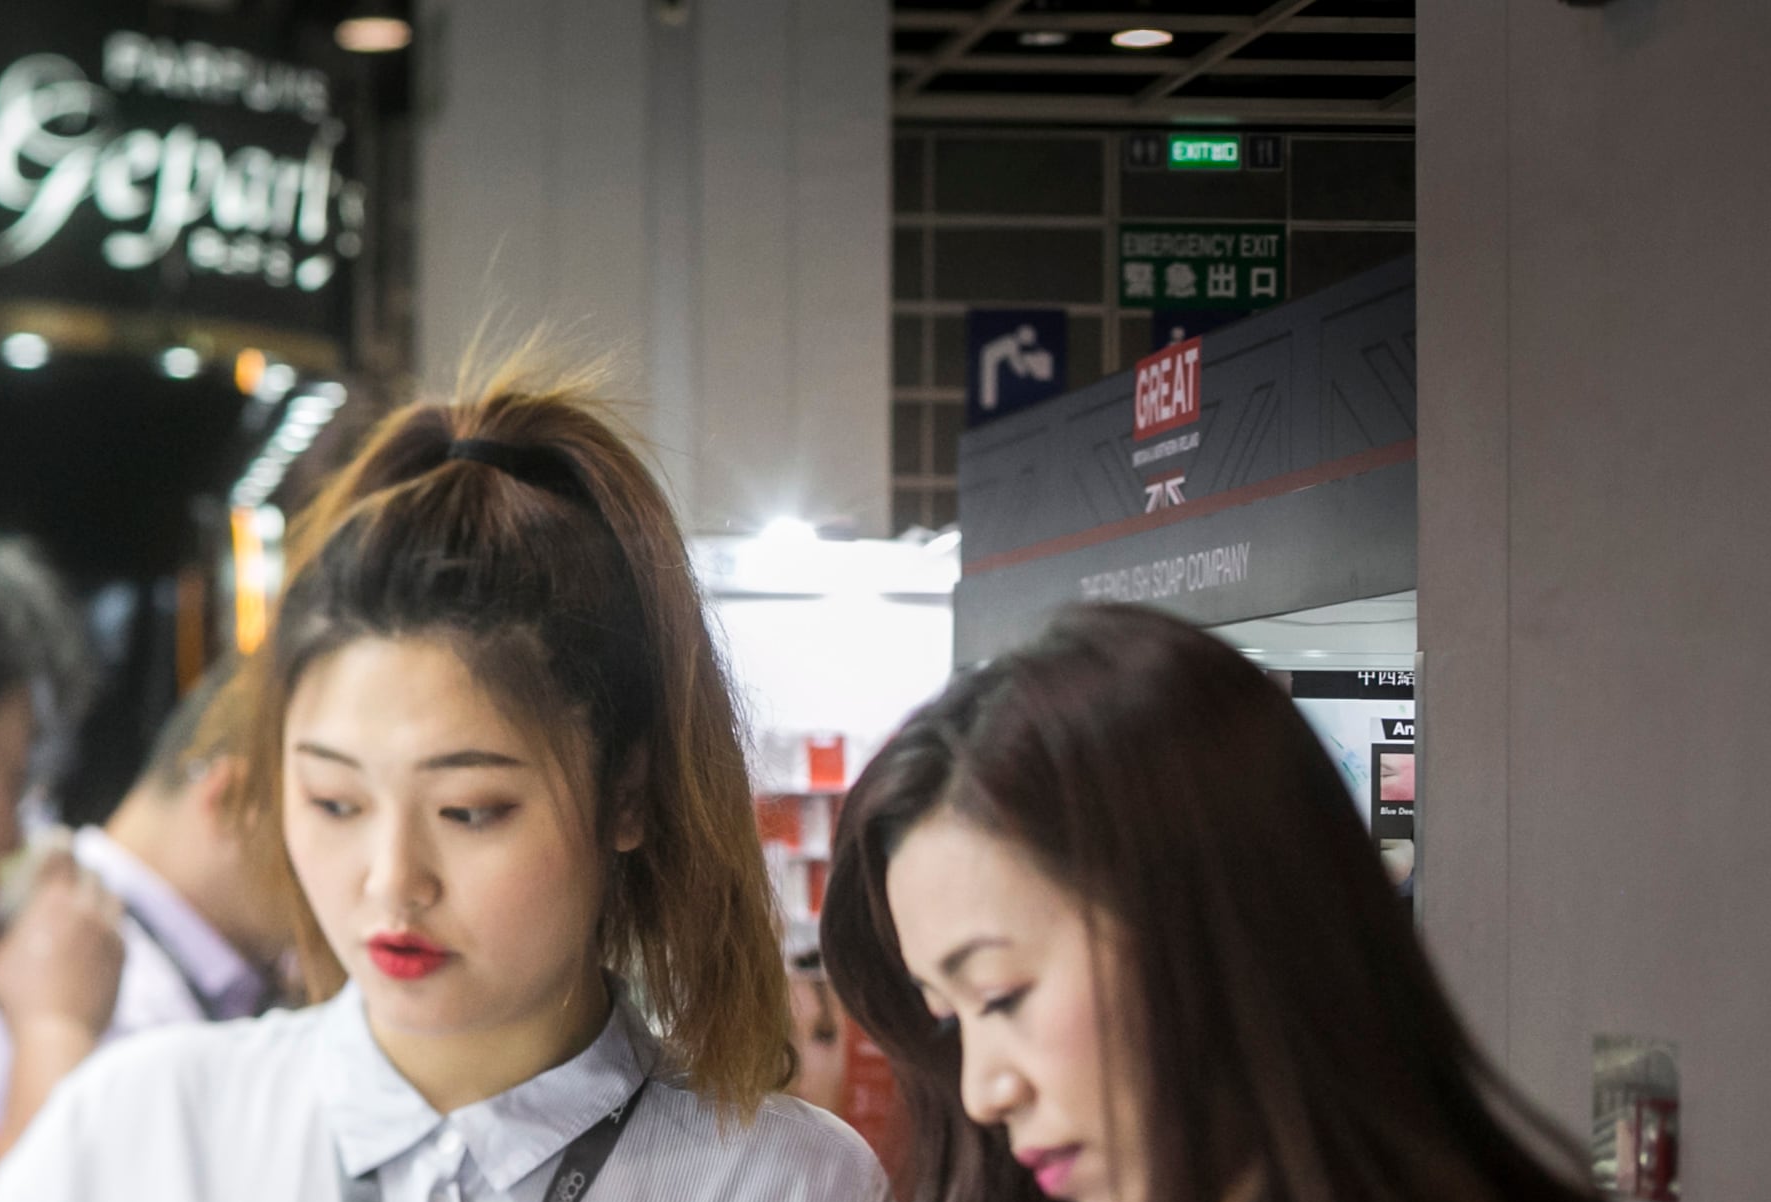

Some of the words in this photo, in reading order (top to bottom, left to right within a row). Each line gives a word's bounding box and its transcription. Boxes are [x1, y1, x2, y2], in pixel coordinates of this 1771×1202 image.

[1172, 141, 1210, 161] EXIT
[1123, 233, 1236, 258] EMERGENCY
[1240, 234, 1279, 258] EXIT
[1124, 262, 1277, 298] 緊急出口
[1135, 347, 1199, 430] GREAT
[1153, 557, 1184, 598] SOAP
[1186, 542, 1250, 592] COMPANY
[1380, 806, 1397, 816] Blue
